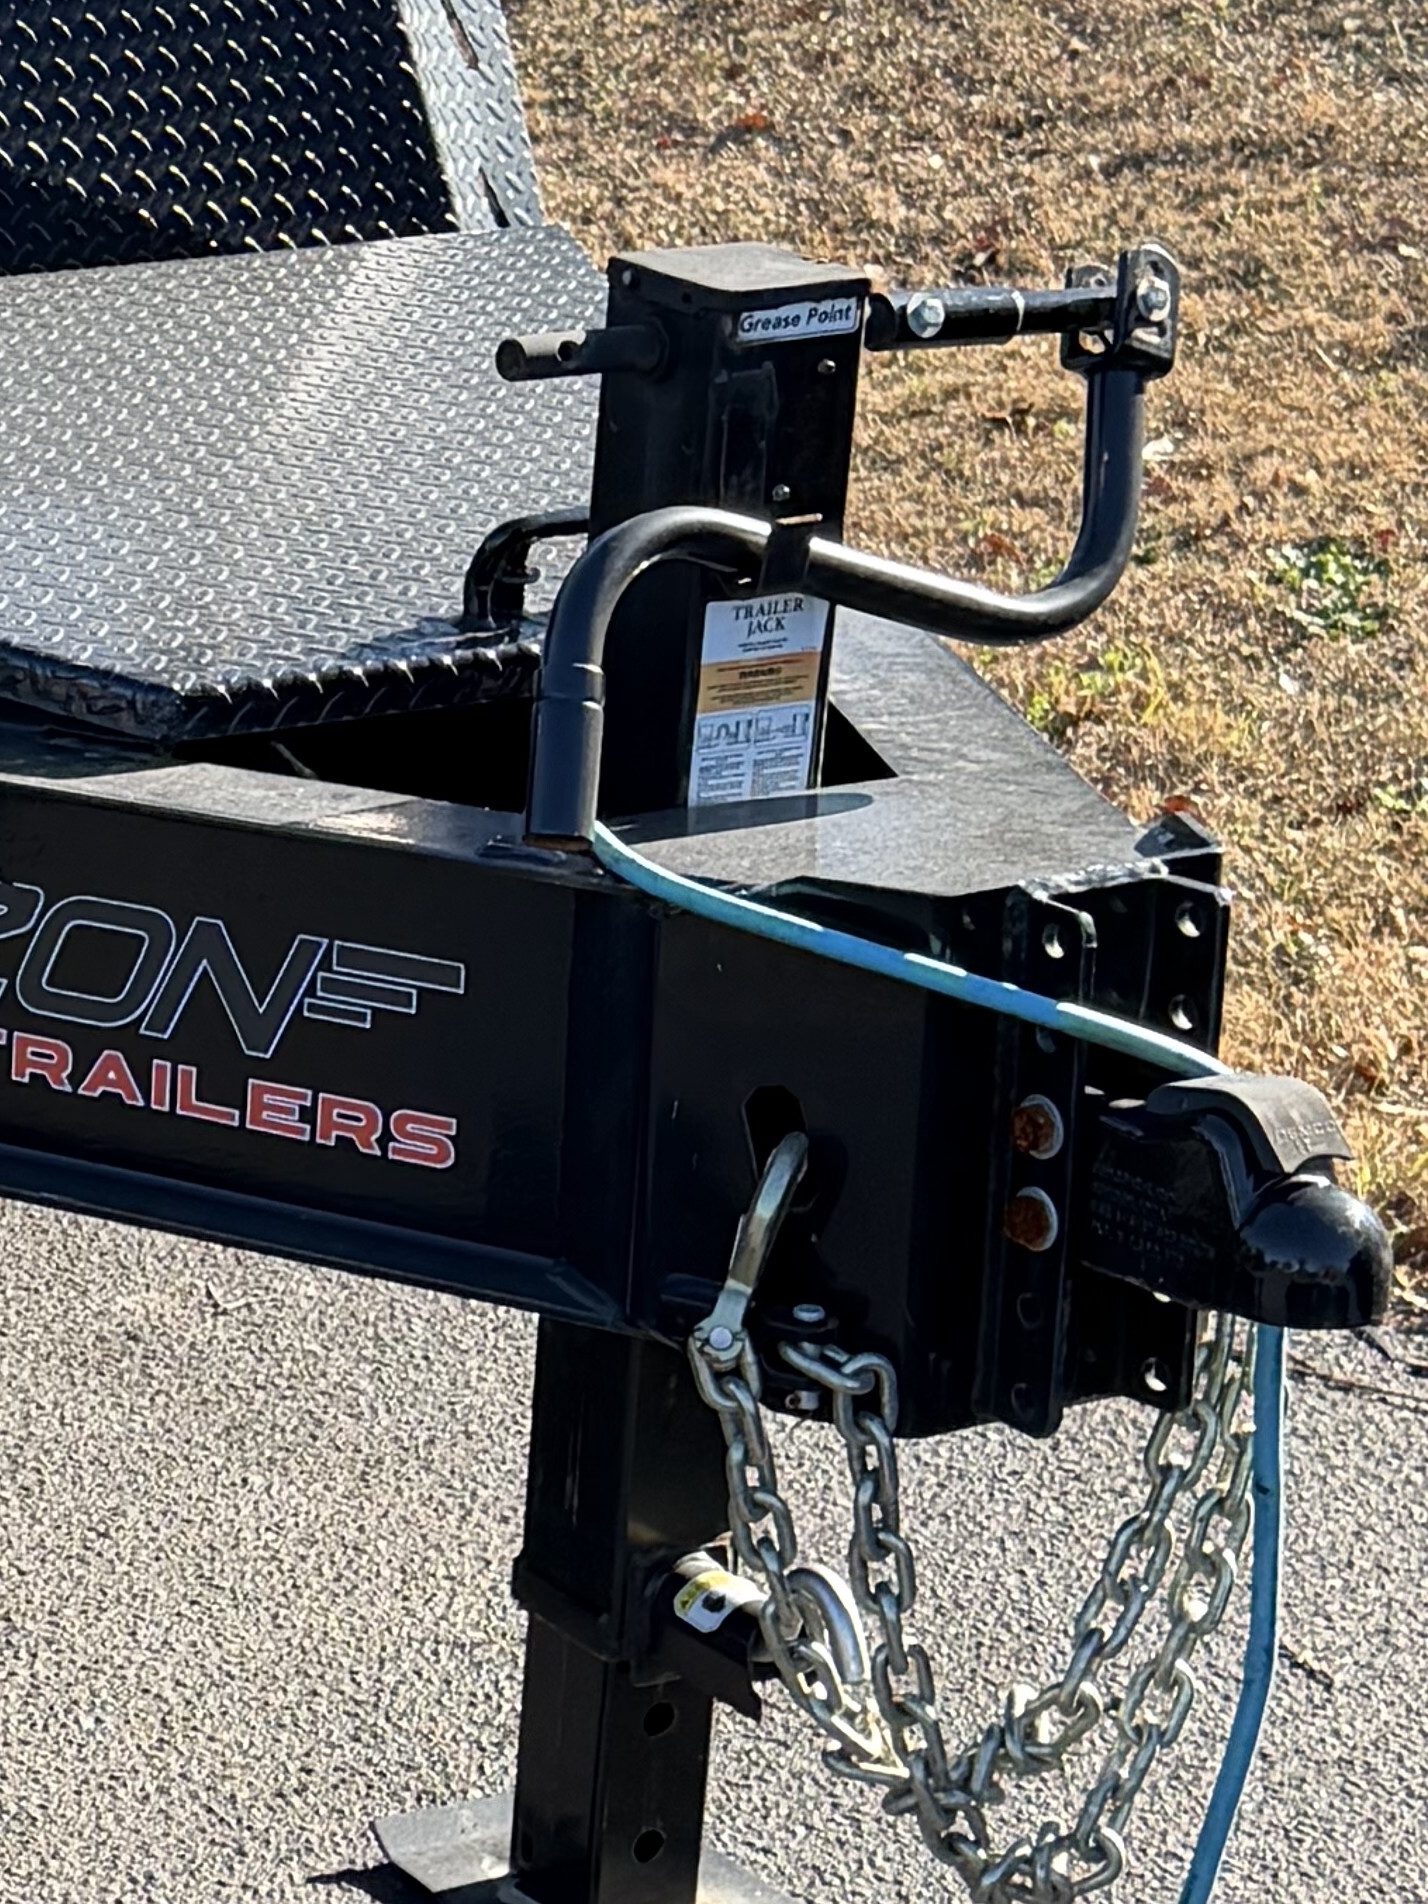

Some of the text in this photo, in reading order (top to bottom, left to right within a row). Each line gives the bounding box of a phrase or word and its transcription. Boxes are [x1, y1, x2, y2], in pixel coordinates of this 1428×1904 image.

[740, 303, 852, 334] Grease Point
[732, 596, 805, 622] TRAILER
[746, 616, 787, 639] JACK
